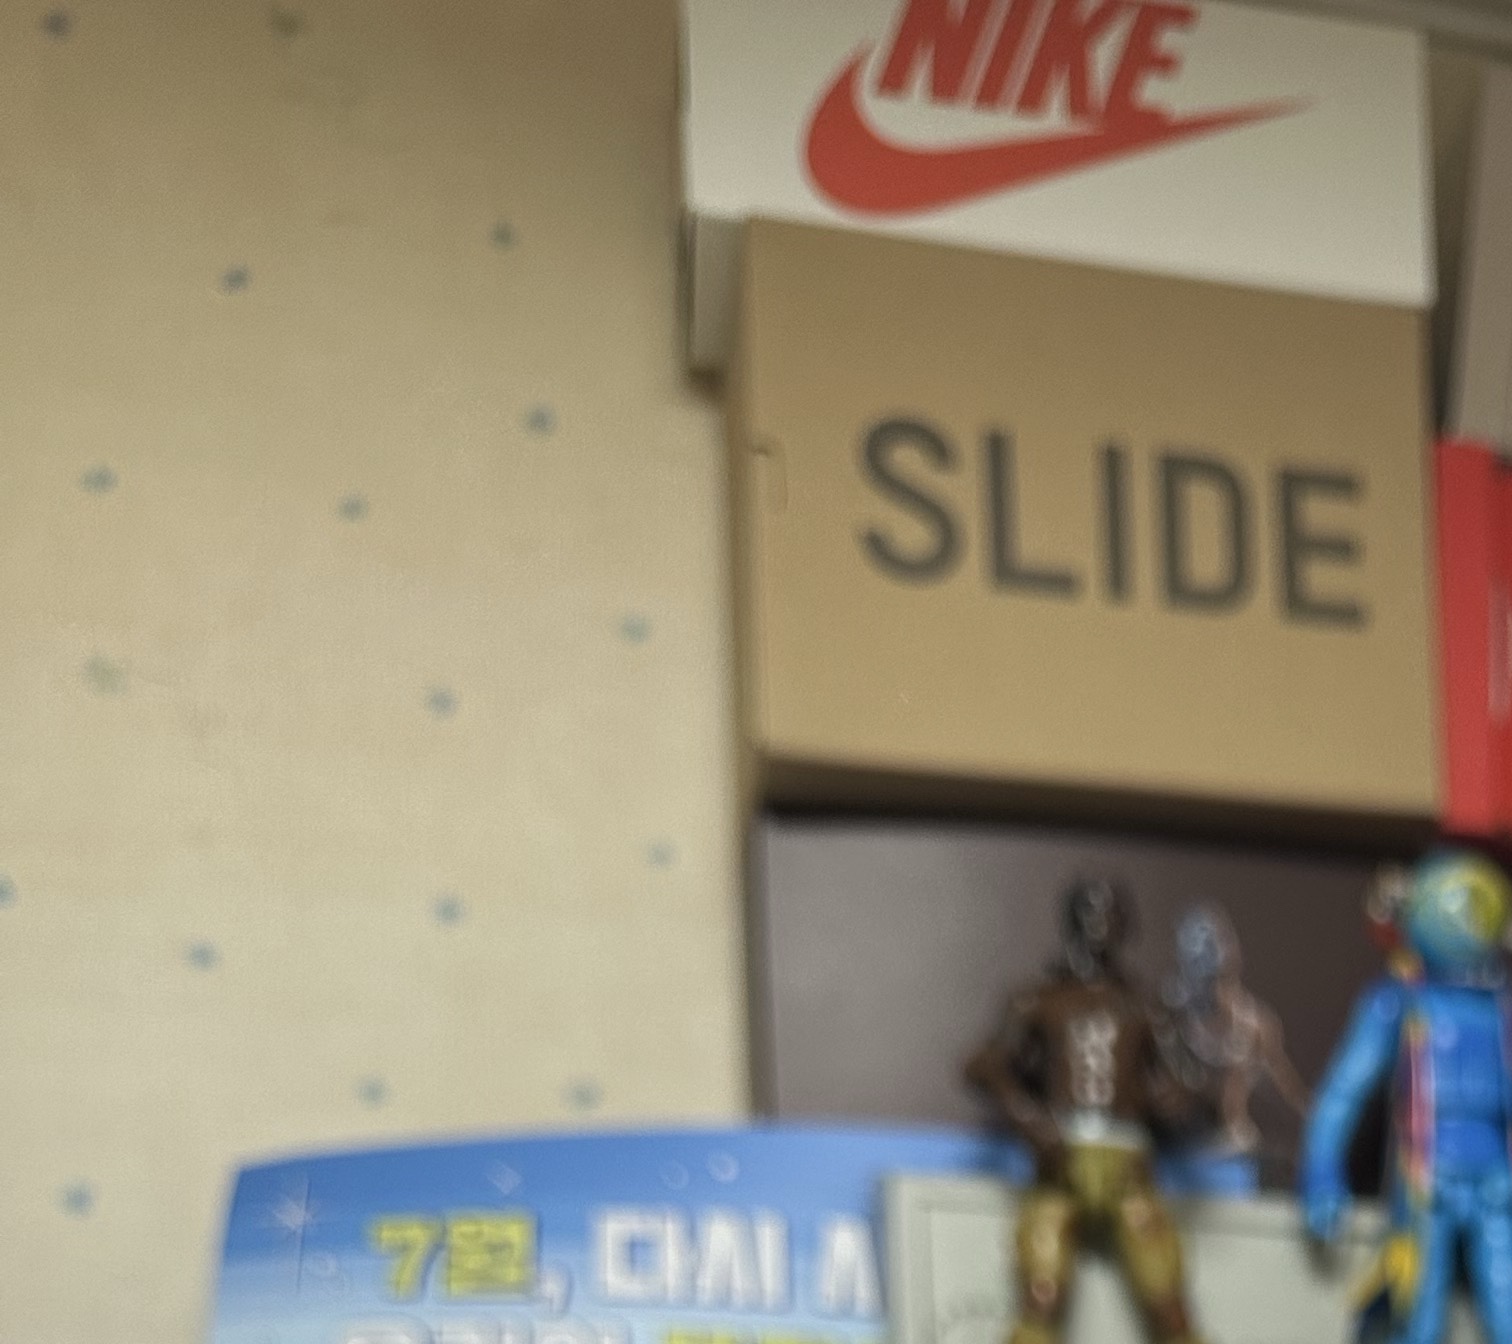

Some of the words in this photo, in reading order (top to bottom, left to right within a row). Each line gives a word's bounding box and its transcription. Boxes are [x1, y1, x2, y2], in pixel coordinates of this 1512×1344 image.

[874, 0, 1200, 132] NIKE
[857, 412, 1370, 632] SLIDE
[369, 1208, 573, 1314] 7월,
[592, 1207, 792, 1316] 다시
